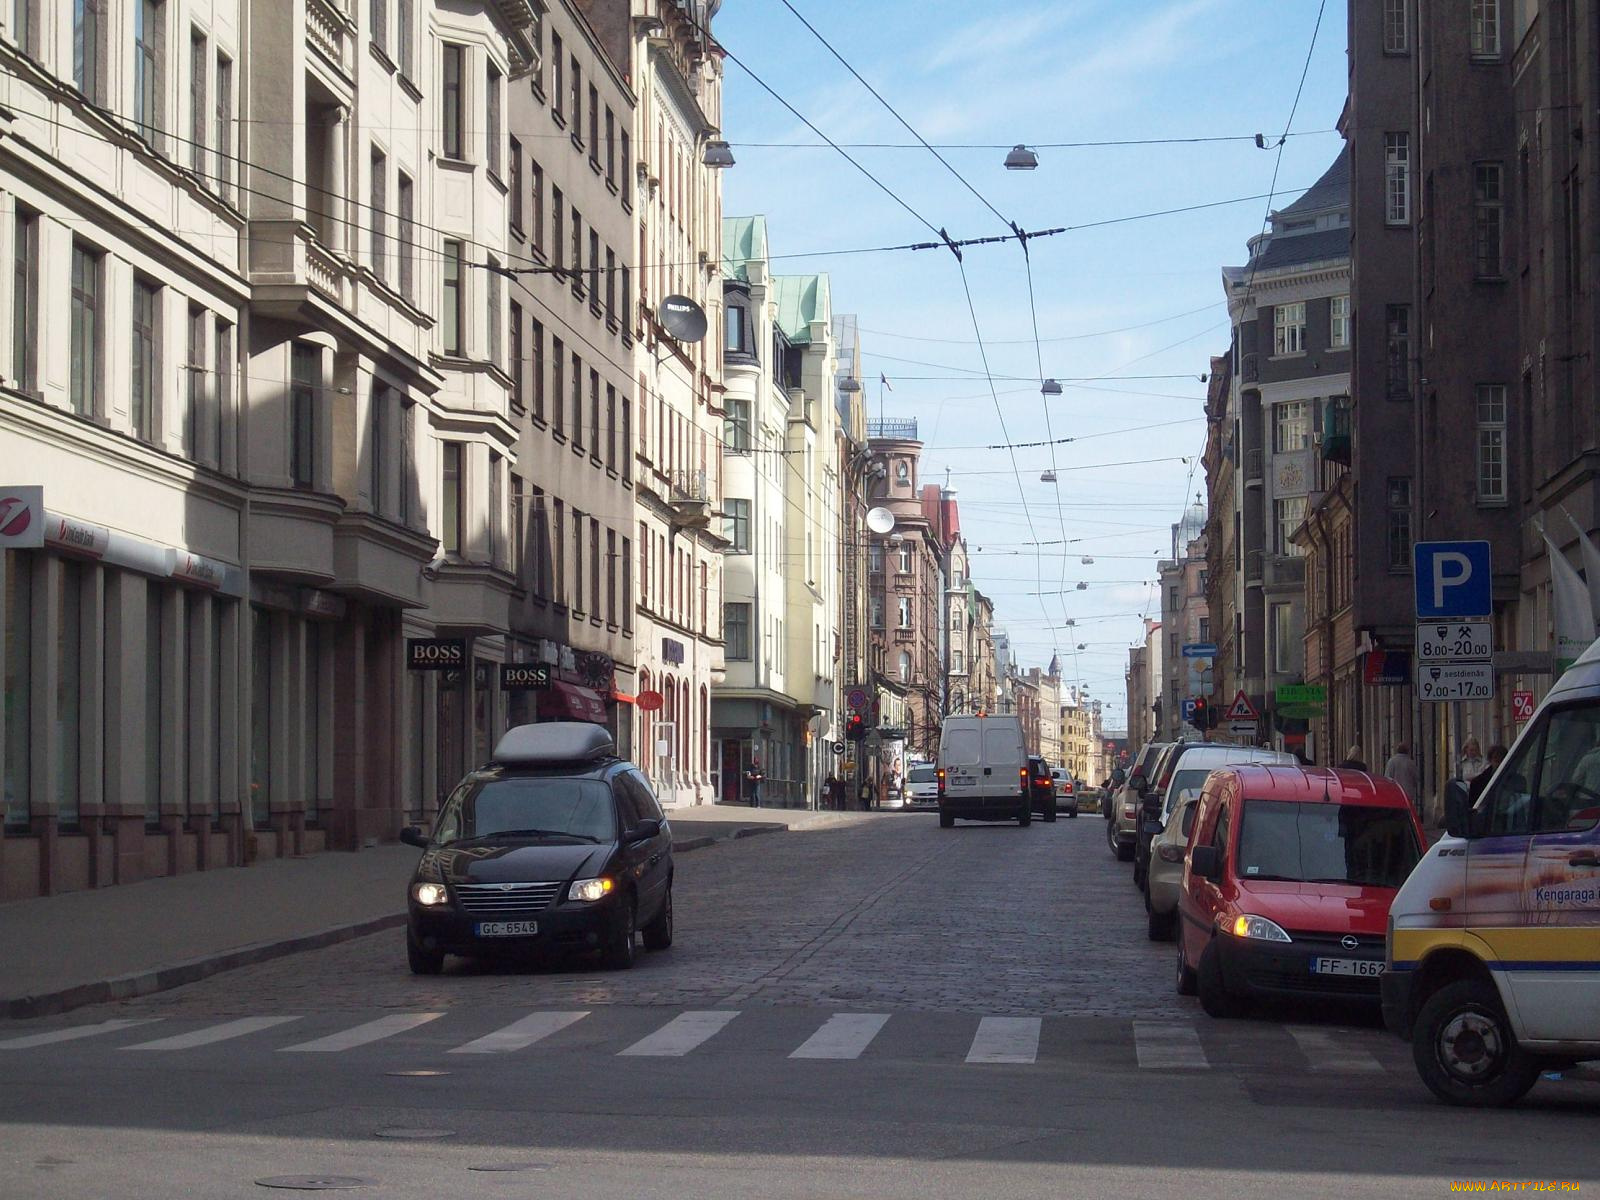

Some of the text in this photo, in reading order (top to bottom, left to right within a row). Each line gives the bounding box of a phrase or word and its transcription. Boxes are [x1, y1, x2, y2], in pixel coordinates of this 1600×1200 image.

[1433, 552, 1472, 608] P
[414, 645, 461, 659] BOSS
[506, 669, 547, 681] BOSS
[1536, 888, 1594, 903] Kengaraga
[483, 922, 536, 934] GC-6548
[1320, 960, 1386, 976] FF-1662
